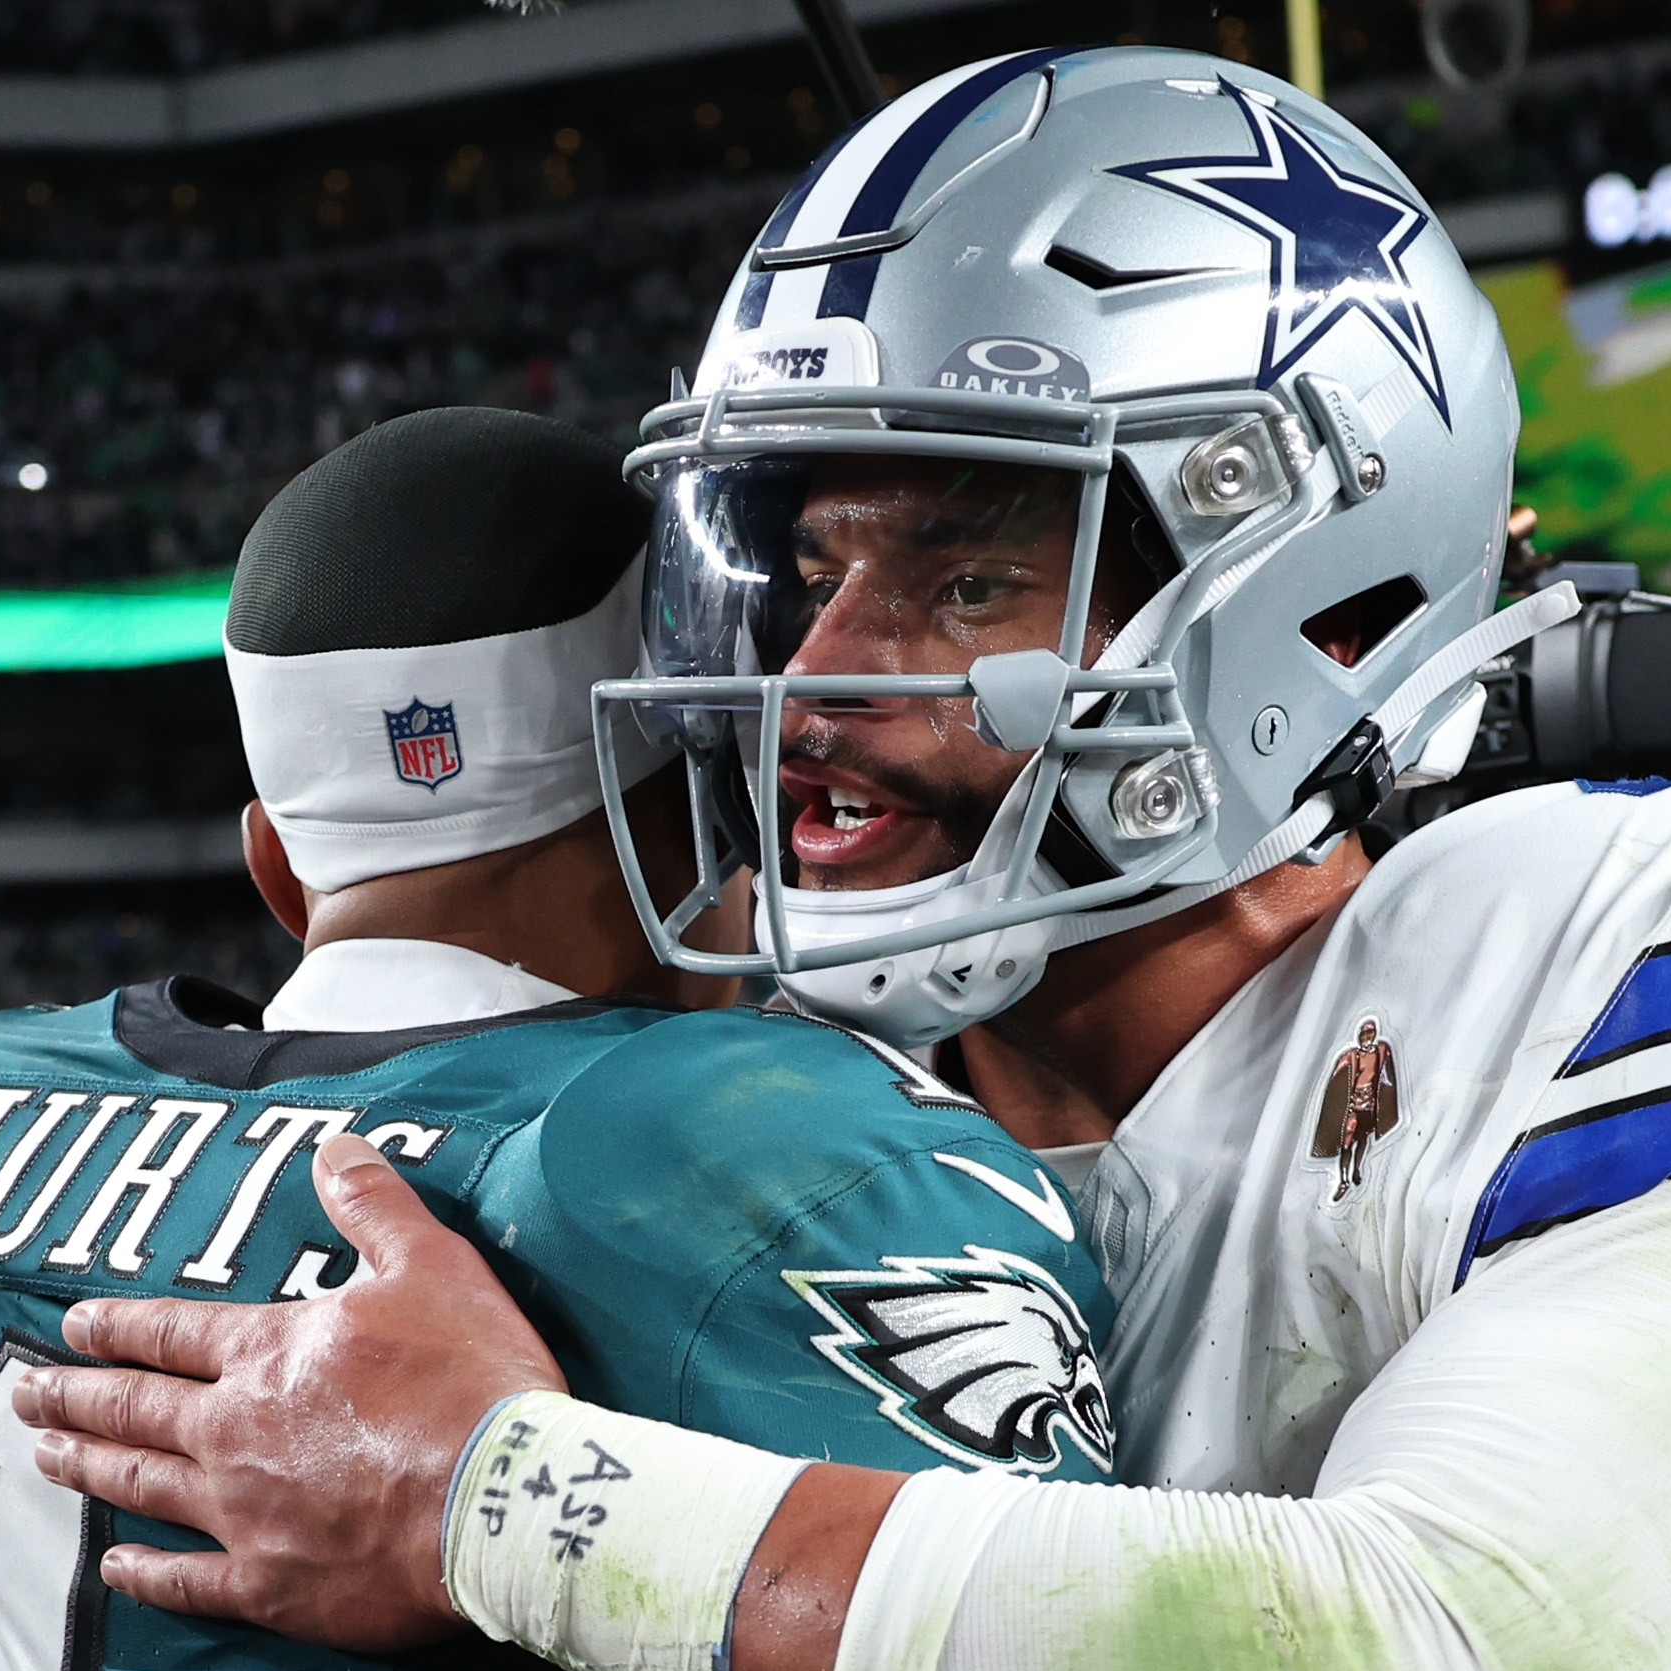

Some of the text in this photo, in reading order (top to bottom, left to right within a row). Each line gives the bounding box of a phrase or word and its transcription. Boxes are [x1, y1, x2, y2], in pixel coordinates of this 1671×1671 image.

[940, 371, 1078, 402] OAKLEY
[399, 740, 452, 777] NFL
[548, 1438, 633, 1564] ASK
